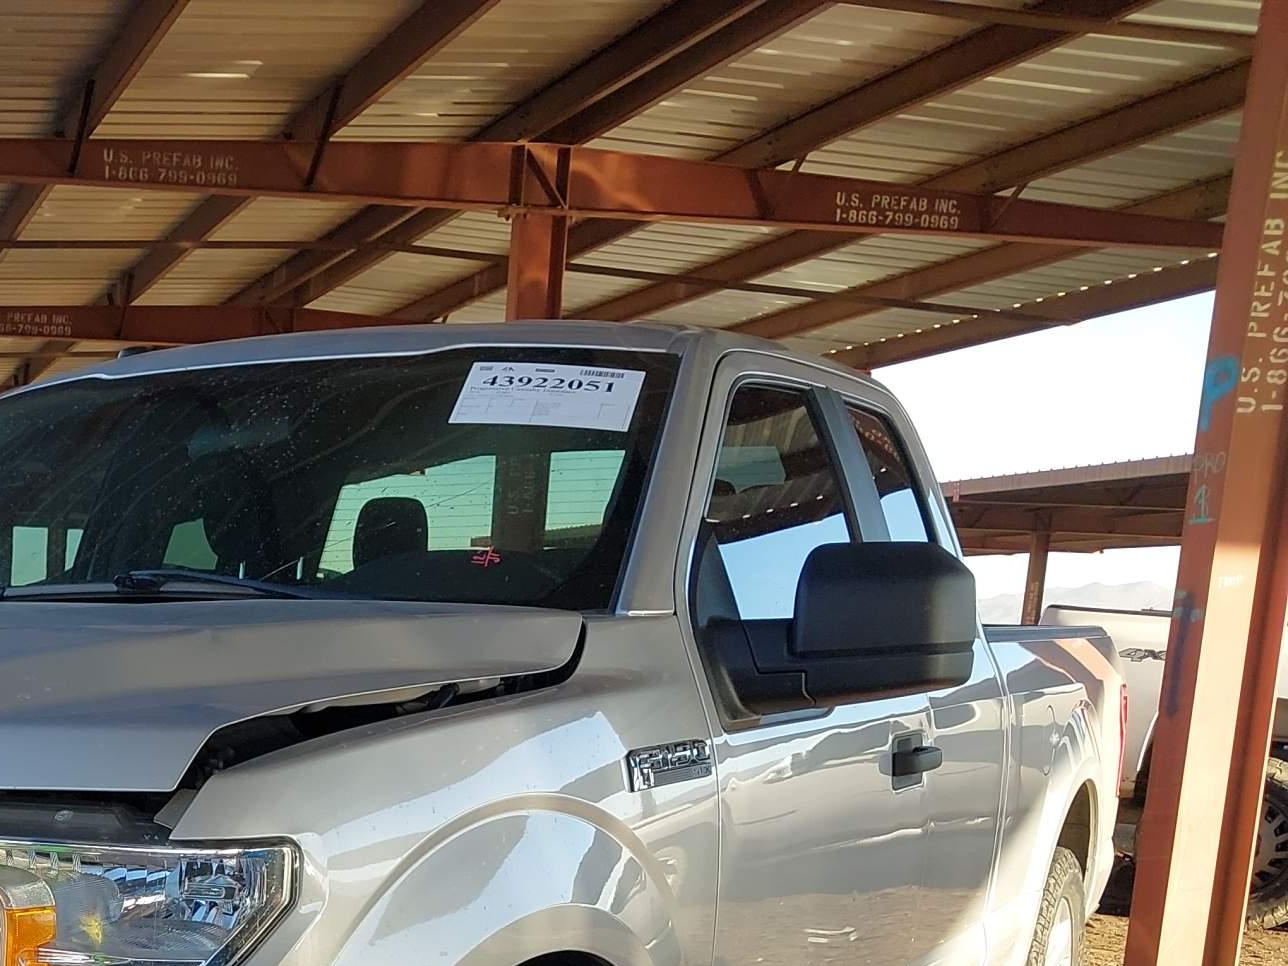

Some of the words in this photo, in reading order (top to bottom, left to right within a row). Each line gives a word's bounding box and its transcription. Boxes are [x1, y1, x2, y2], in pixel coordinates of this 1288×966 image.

[142, 151, 204, 169] PREFAB
[835, 191, 864, 208] U.S.
[872, 194, 928, 211] PREFAB
[934, 198, 961, 214] INC.
[835, 207, 959, 229] 1-866-799-0969
[1247, 218, 1285, 338] PREFAB
[482, 375, 615, 393] 43922051
[1236, 358, 1264, 413] U.S.
